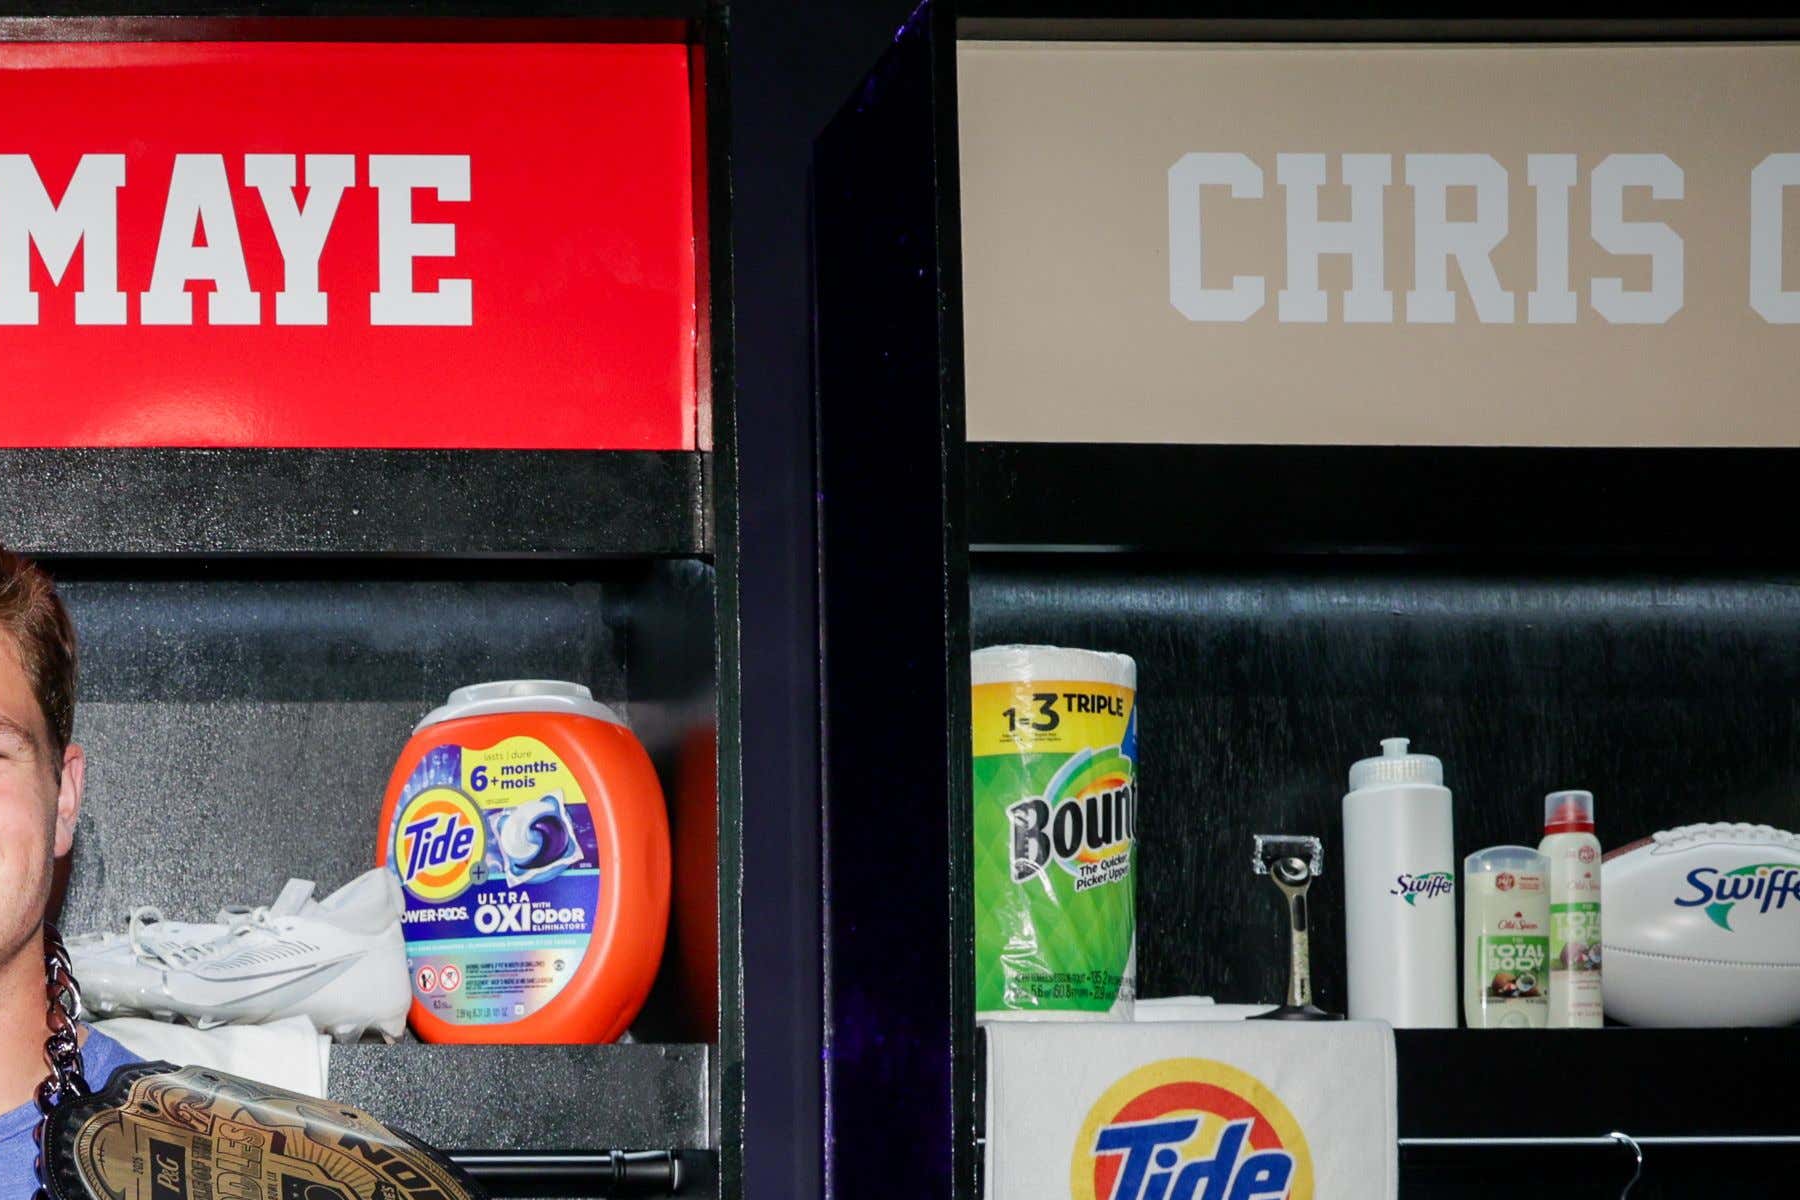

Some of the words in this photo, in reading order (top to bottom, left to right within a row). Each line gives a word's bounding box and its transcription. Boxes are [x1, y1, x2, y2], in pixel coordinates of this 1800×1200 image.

[1167, 152, 1685, 324] CHRIS
[1062, 693, 1124, 717] TRIPLE
[501, 761, 557, 776] months
[501, 777, 536, 789] mois
[405, 813, 476, 880] Tide
[1080, 864, 1098, 877] The
[1076, 873, 1108, 891] Picker
[1390, 874, 1453, 899] Swiffer
[478, 891, 529, 905] ULTRA
[474, 903, 531, 934] OXI
[532, 908, 585, 924] ODOR
[1488, 944, 1544, 957] TOTAL
[1489, 957, 1543, 971] BODY
[156, 1153, 182, 1194] P&G
